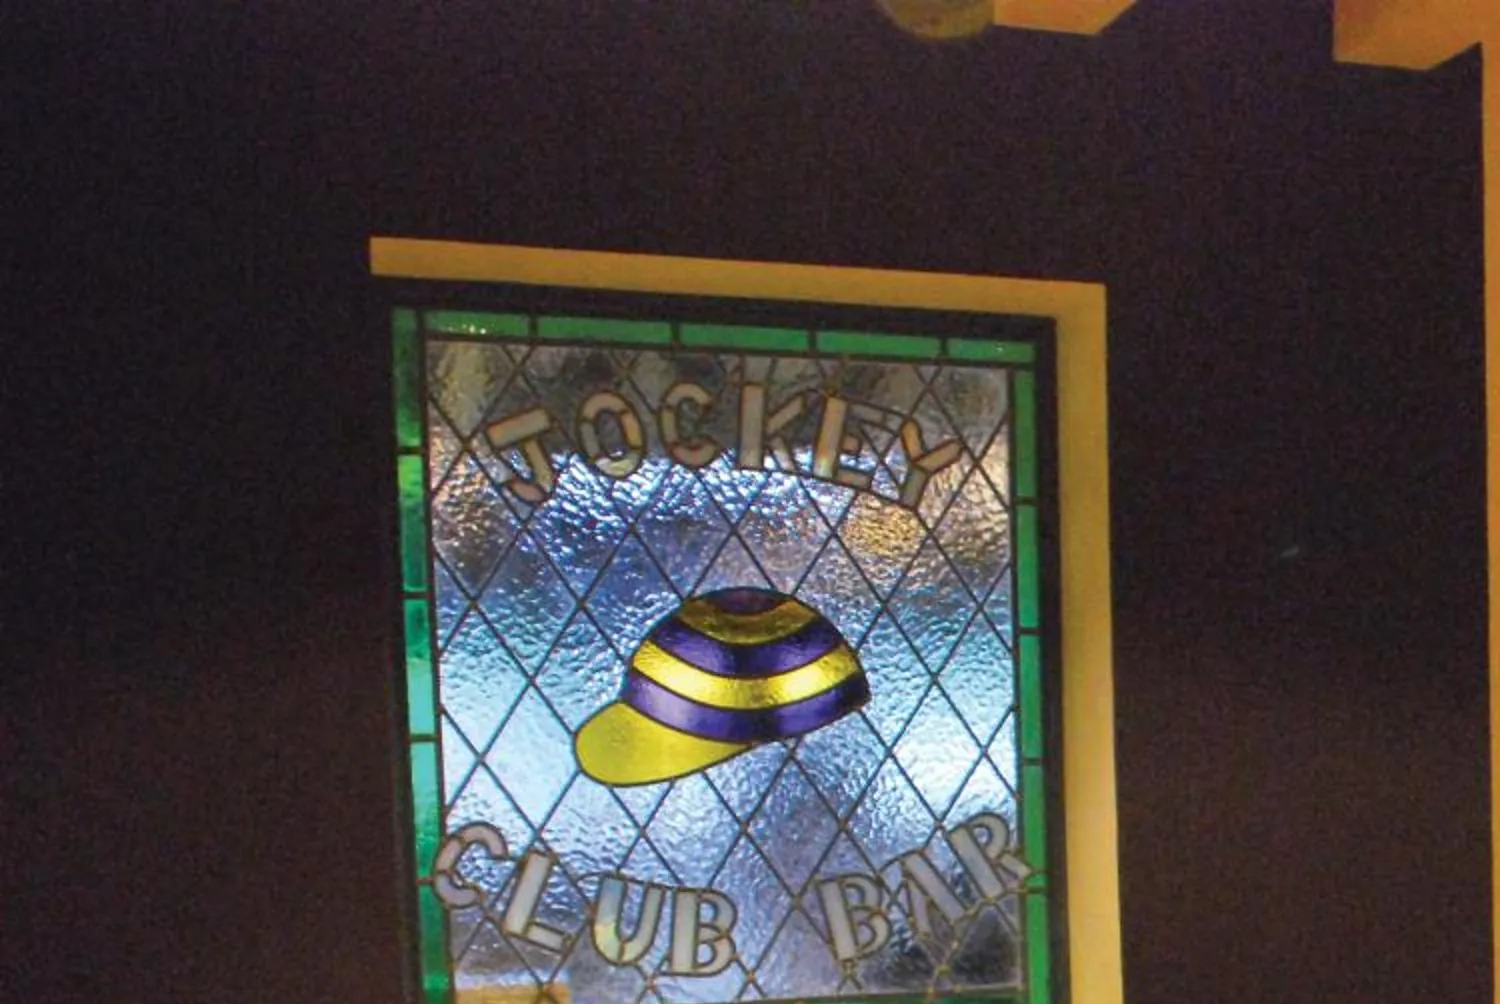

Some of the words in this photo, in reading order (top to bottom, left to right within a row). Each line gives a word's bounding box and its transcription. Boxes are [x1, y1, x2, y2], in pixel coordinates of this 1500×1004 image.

[484, 380, 962, 509] JOCKEY
[432, 821, 738, 977] CLUB
[816, 811, 1037, 964] BAR
